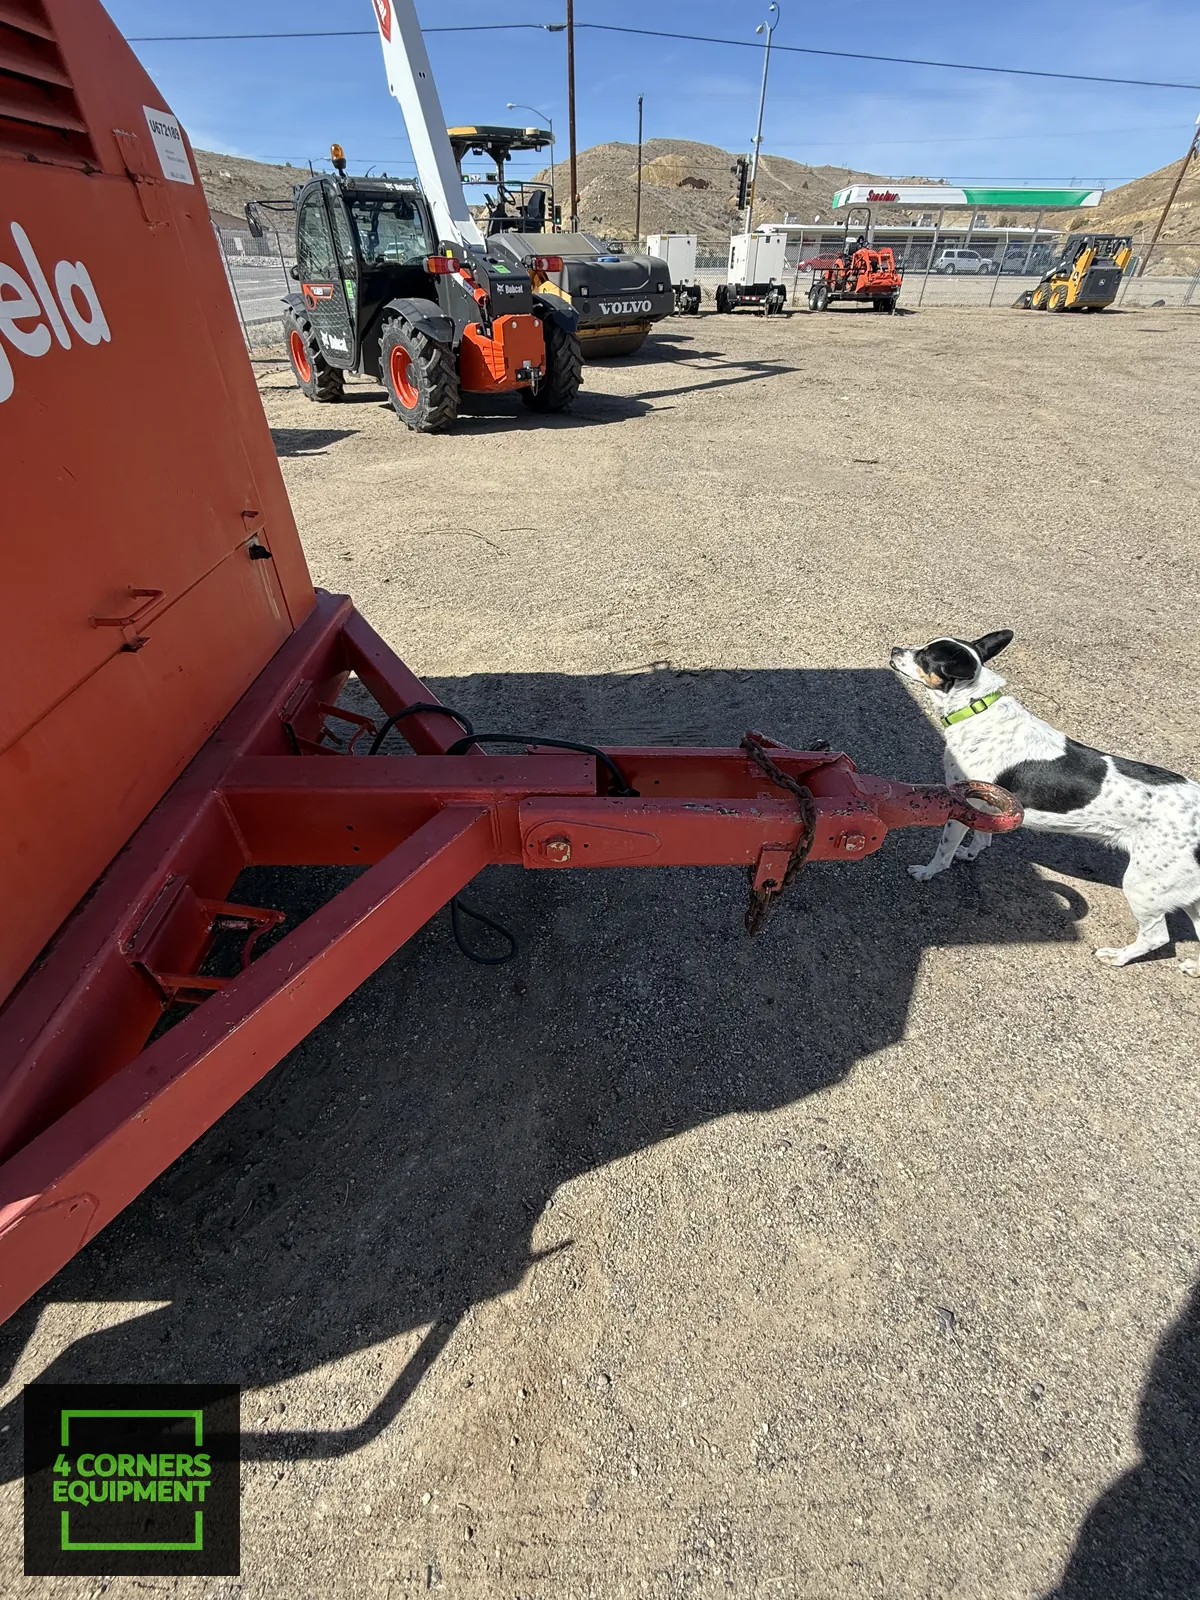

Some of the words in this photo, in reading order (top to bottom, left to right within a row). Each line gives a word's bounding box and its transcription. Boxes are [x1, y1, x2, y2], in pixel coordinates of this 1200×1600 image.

[866, 189, 899, 202] Sinclair
[505, 284, 524, 294] Bobcat
[598, 300, 652, 315] VOLVO
